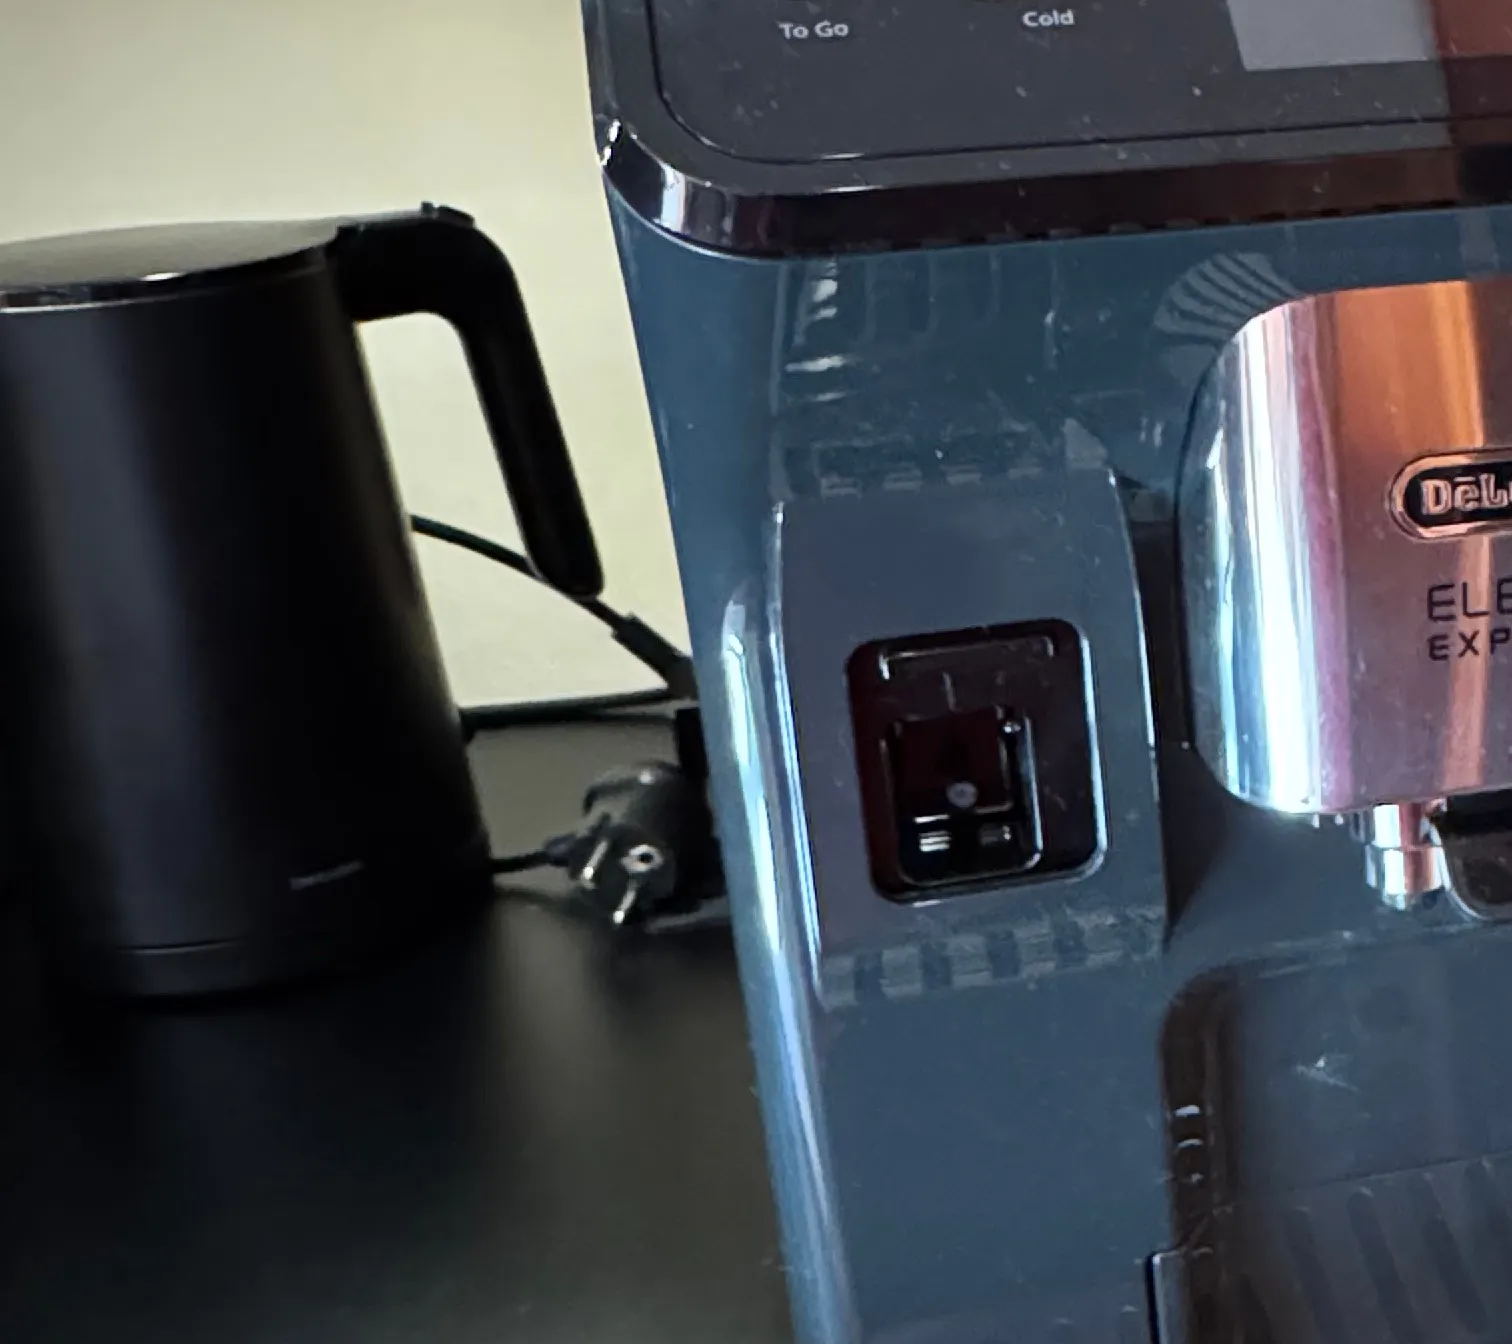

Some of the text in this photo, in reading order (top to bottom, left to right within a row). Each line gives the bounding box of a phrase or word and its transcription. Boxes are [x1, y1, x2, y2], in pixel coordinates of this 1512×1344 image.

[1022, 8, 1075, 27] Cold
[778, 20, 849, 39] To Go
